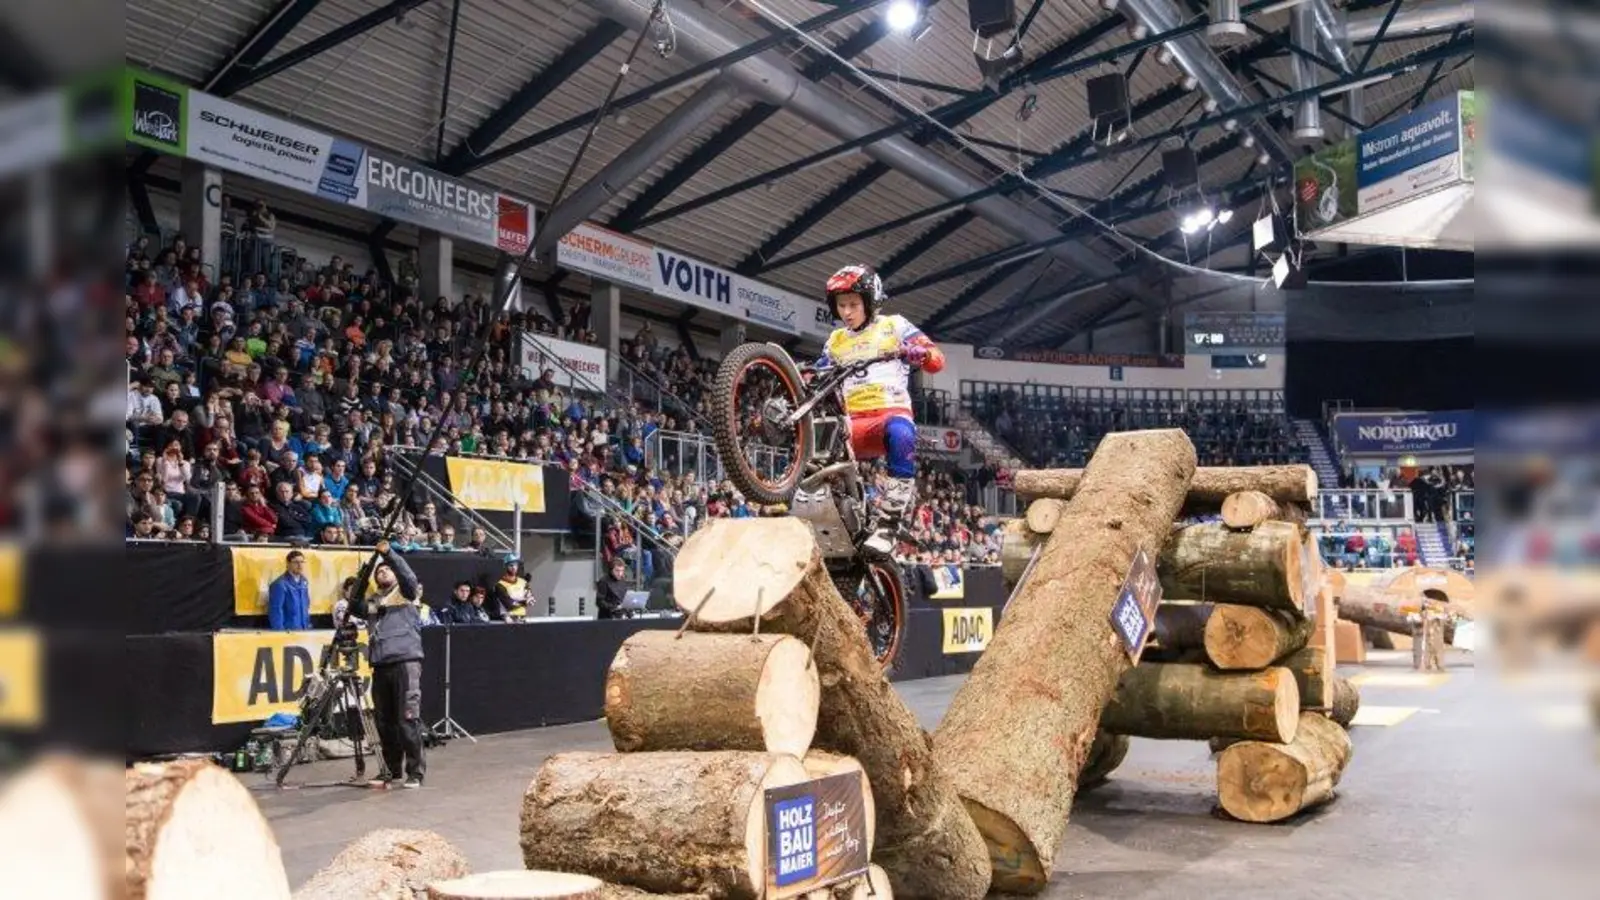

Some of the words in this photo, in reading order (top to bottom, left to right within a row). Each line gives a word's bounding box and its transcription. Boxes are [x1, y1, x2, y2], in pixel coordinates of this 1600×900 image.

[200, 110, 319, 156] SCHWEIGER
[367, 154, 493, 220] ERGONEERS
[656, 251, 731, 305] VOITH
[951, 616, 985, 645] ADAC
[779, 803, 813, 830] HOLZ
[780, 825, 813, 857] BAU
[780, 851, 814, 876] MAIER
